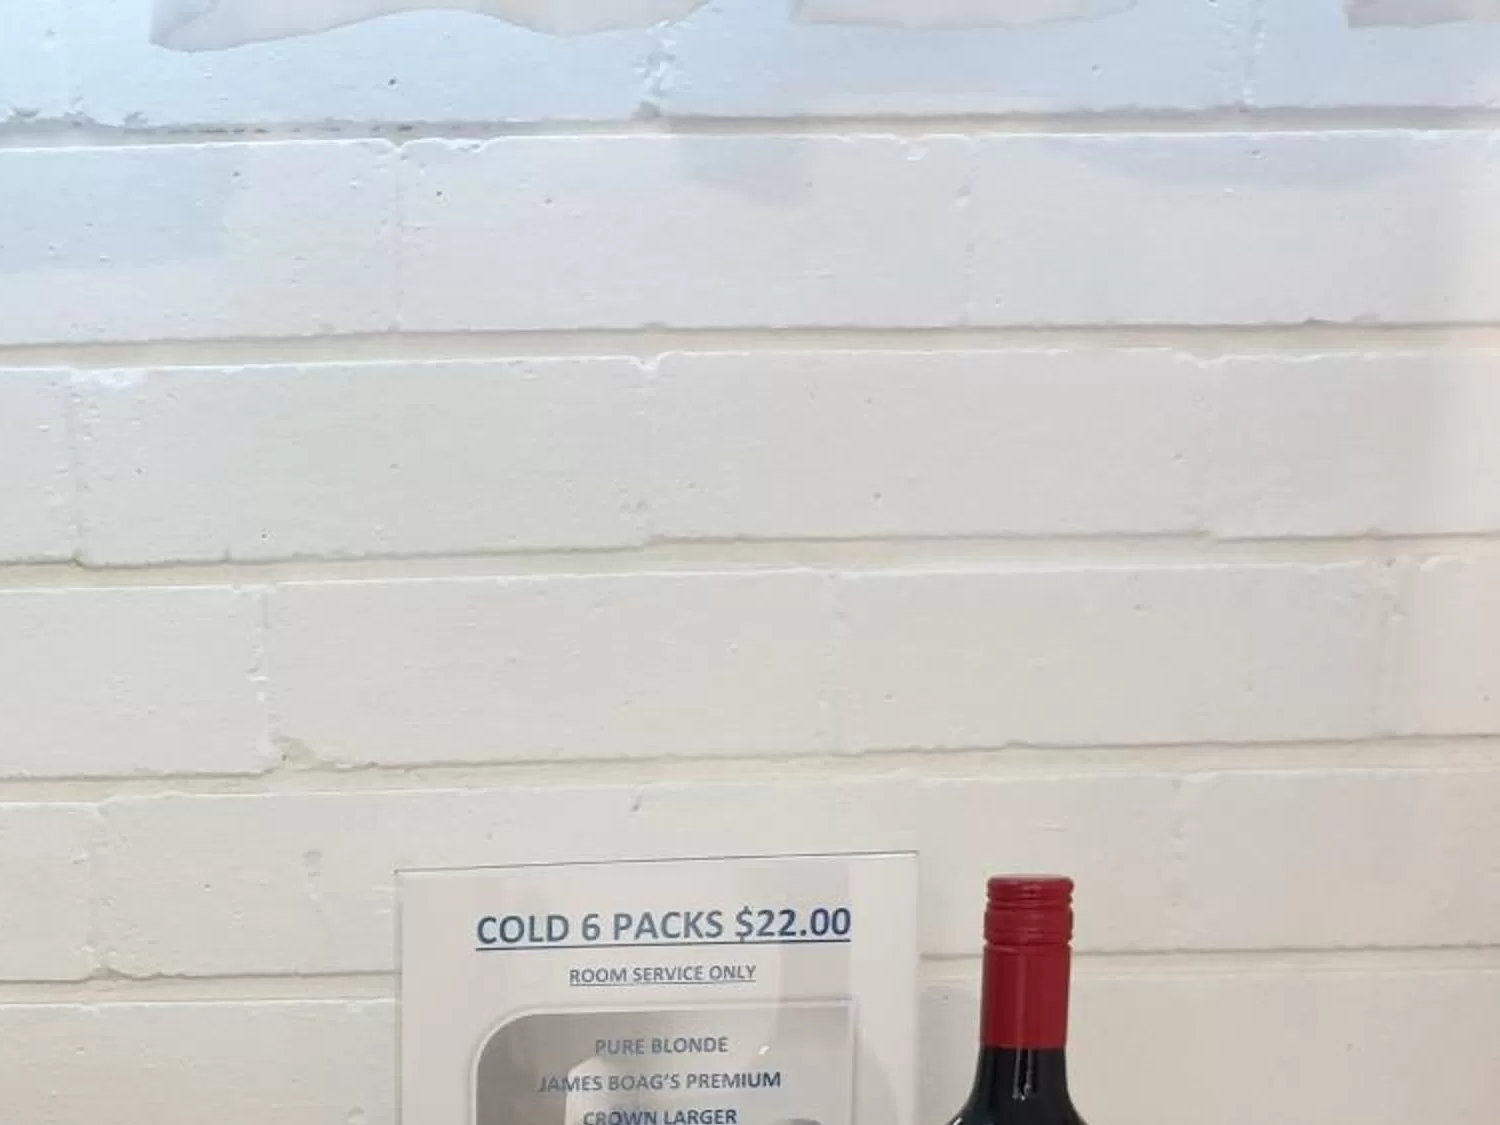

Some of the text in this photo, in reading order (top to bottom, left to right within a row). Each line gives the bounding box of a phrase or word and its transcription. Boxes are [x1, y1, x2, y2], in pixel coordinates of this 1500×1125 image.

[476, 905, 852, 945] COLD 6 PACKS $22.00
[569, 964, 757, 984] ROOM SERVICE ONLY
[595, 1037, 729, 1055] PURE BLONDE
[540, 1071, 782, 1093] JAMES BOAG'S PREMIUM
[664, 1109, 738, 1125] LARGER
